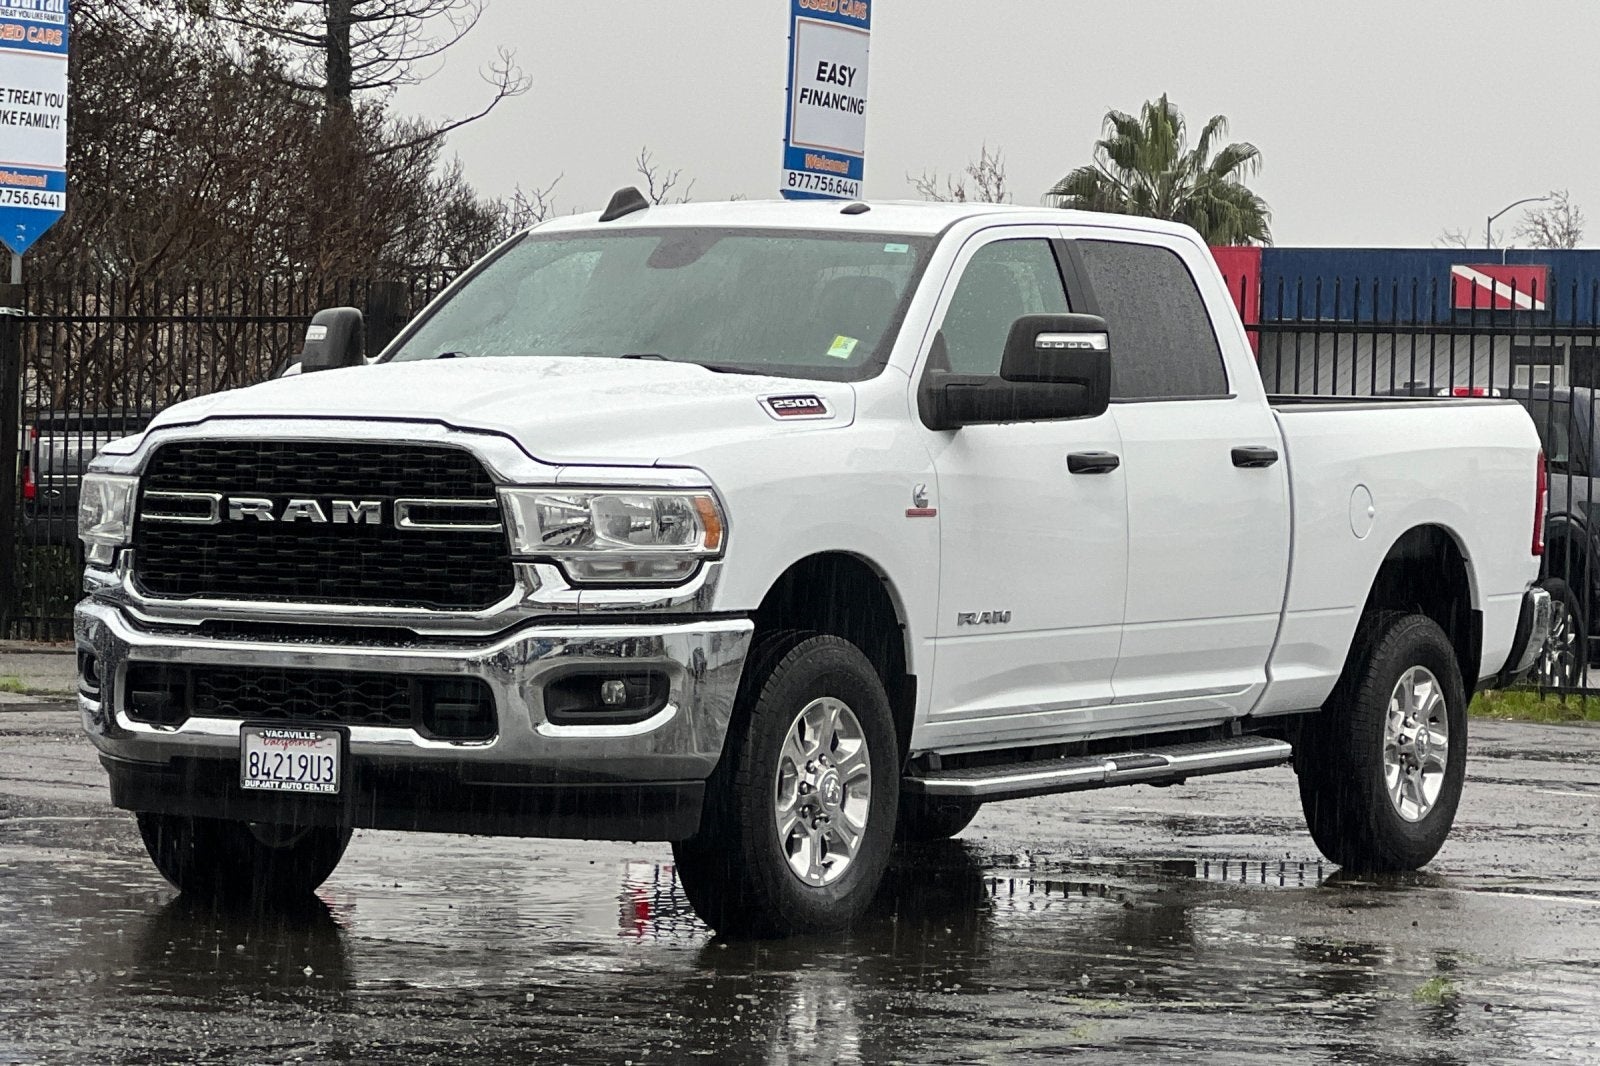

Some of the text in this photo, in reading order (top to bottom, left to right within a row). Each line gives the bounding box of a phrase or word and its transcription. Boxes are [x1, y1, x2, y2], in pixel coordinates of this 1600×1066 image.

[839, 0, 867, 20] CARS
[27, 26, 63, 46] CARS
[816, 60, 856, 87] EASY
[8, 88, 43, 106] TREAT
[44, 92, 64, 108] YOU
[799, 87, 865, 115] FINANCING
[19, 111, 60, 129] FAMILY!
[805, 153, 850, 174] Welcome!
[788, 171, 859, 197] 877.756.6441
[772, 398, 819, 409] 2500
[228, 496, 381, 525] RAM
[957, 610, 1012, 626] RAM
[265, 730, 316, 739] VACAVILLE
[249, 751, 333, 783] 84219U3
[281, 780, 303, 789] AUTO
